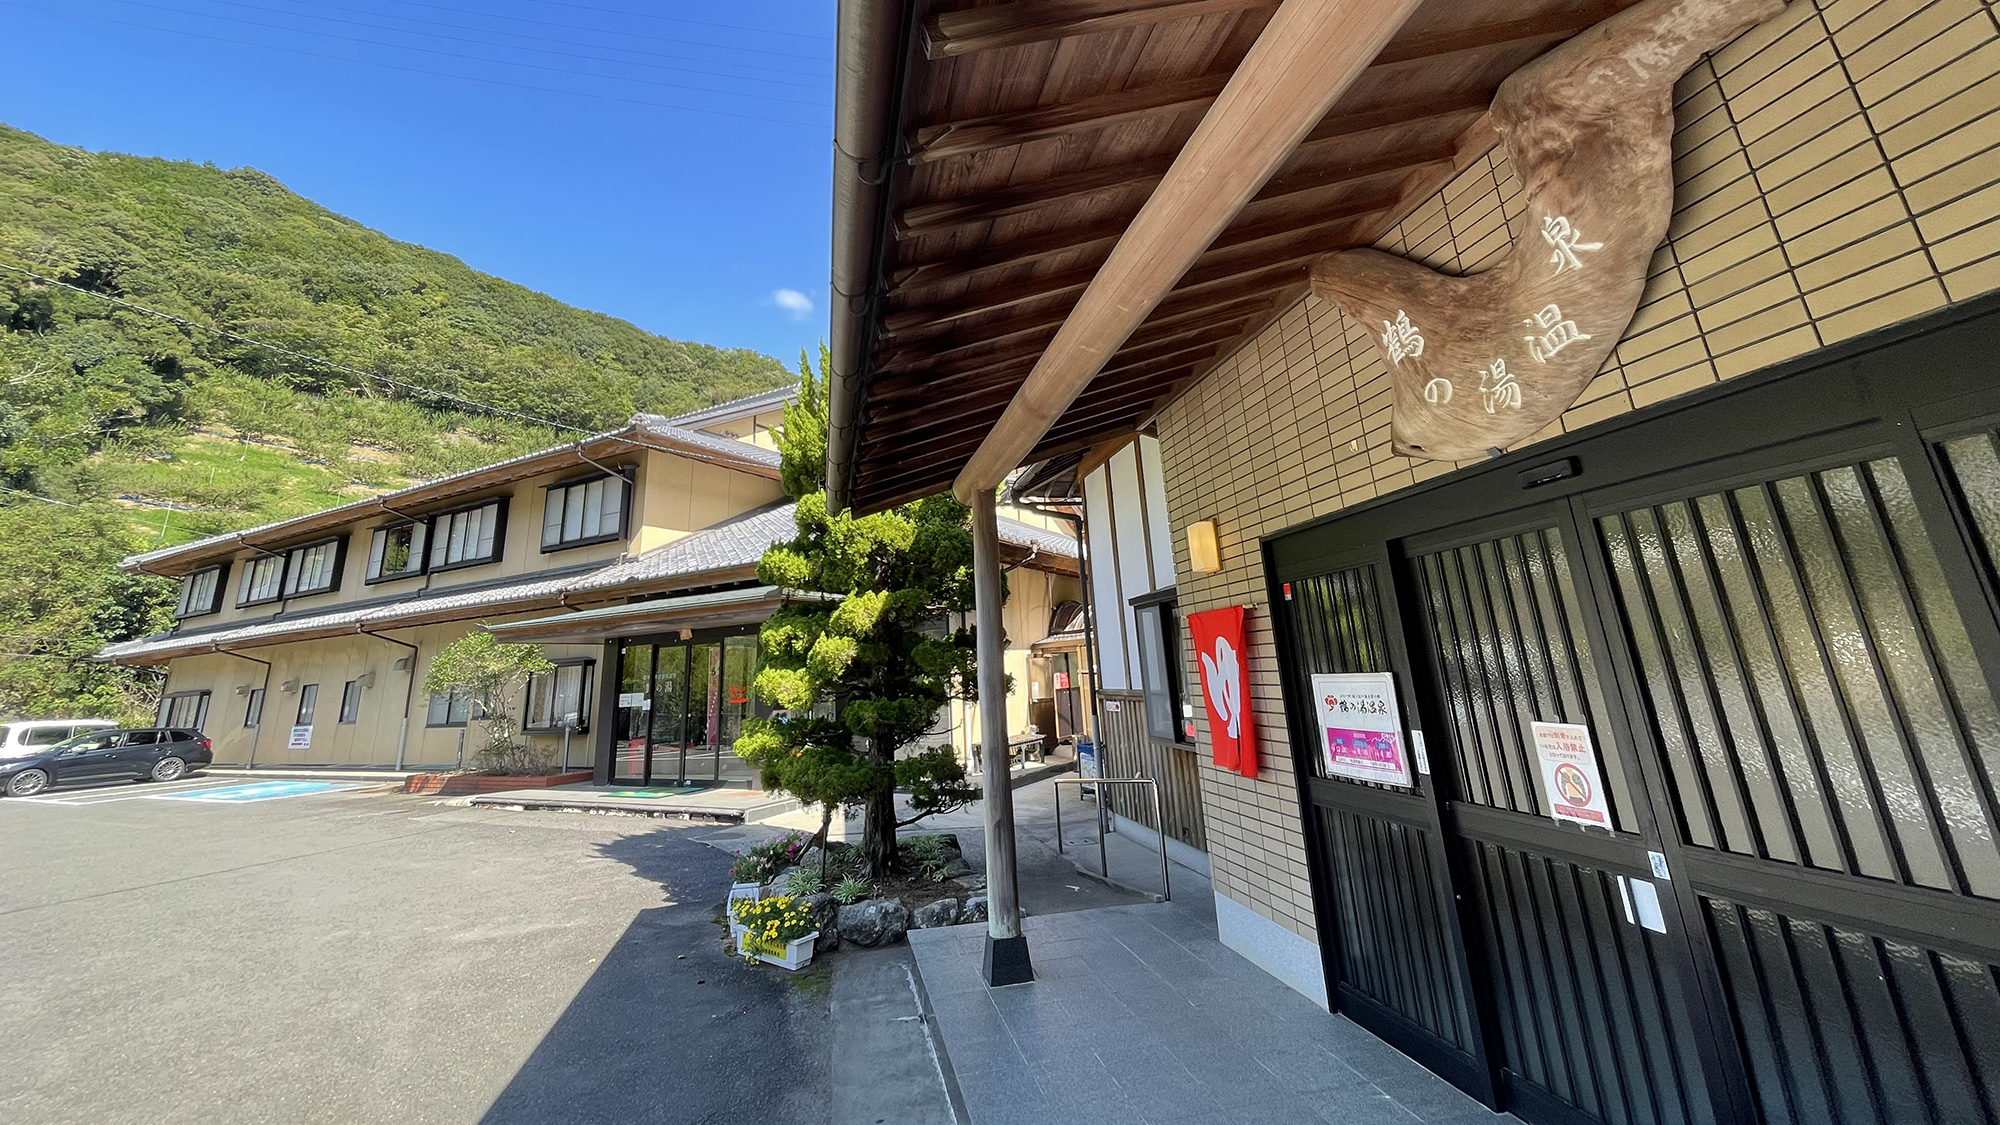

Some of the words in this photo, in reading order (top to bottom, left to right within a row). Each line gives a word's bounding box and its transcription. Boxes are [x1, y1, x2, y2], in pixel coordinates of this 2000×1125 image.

[1381, 216, 1604, 414] 鶴の湯温泉
